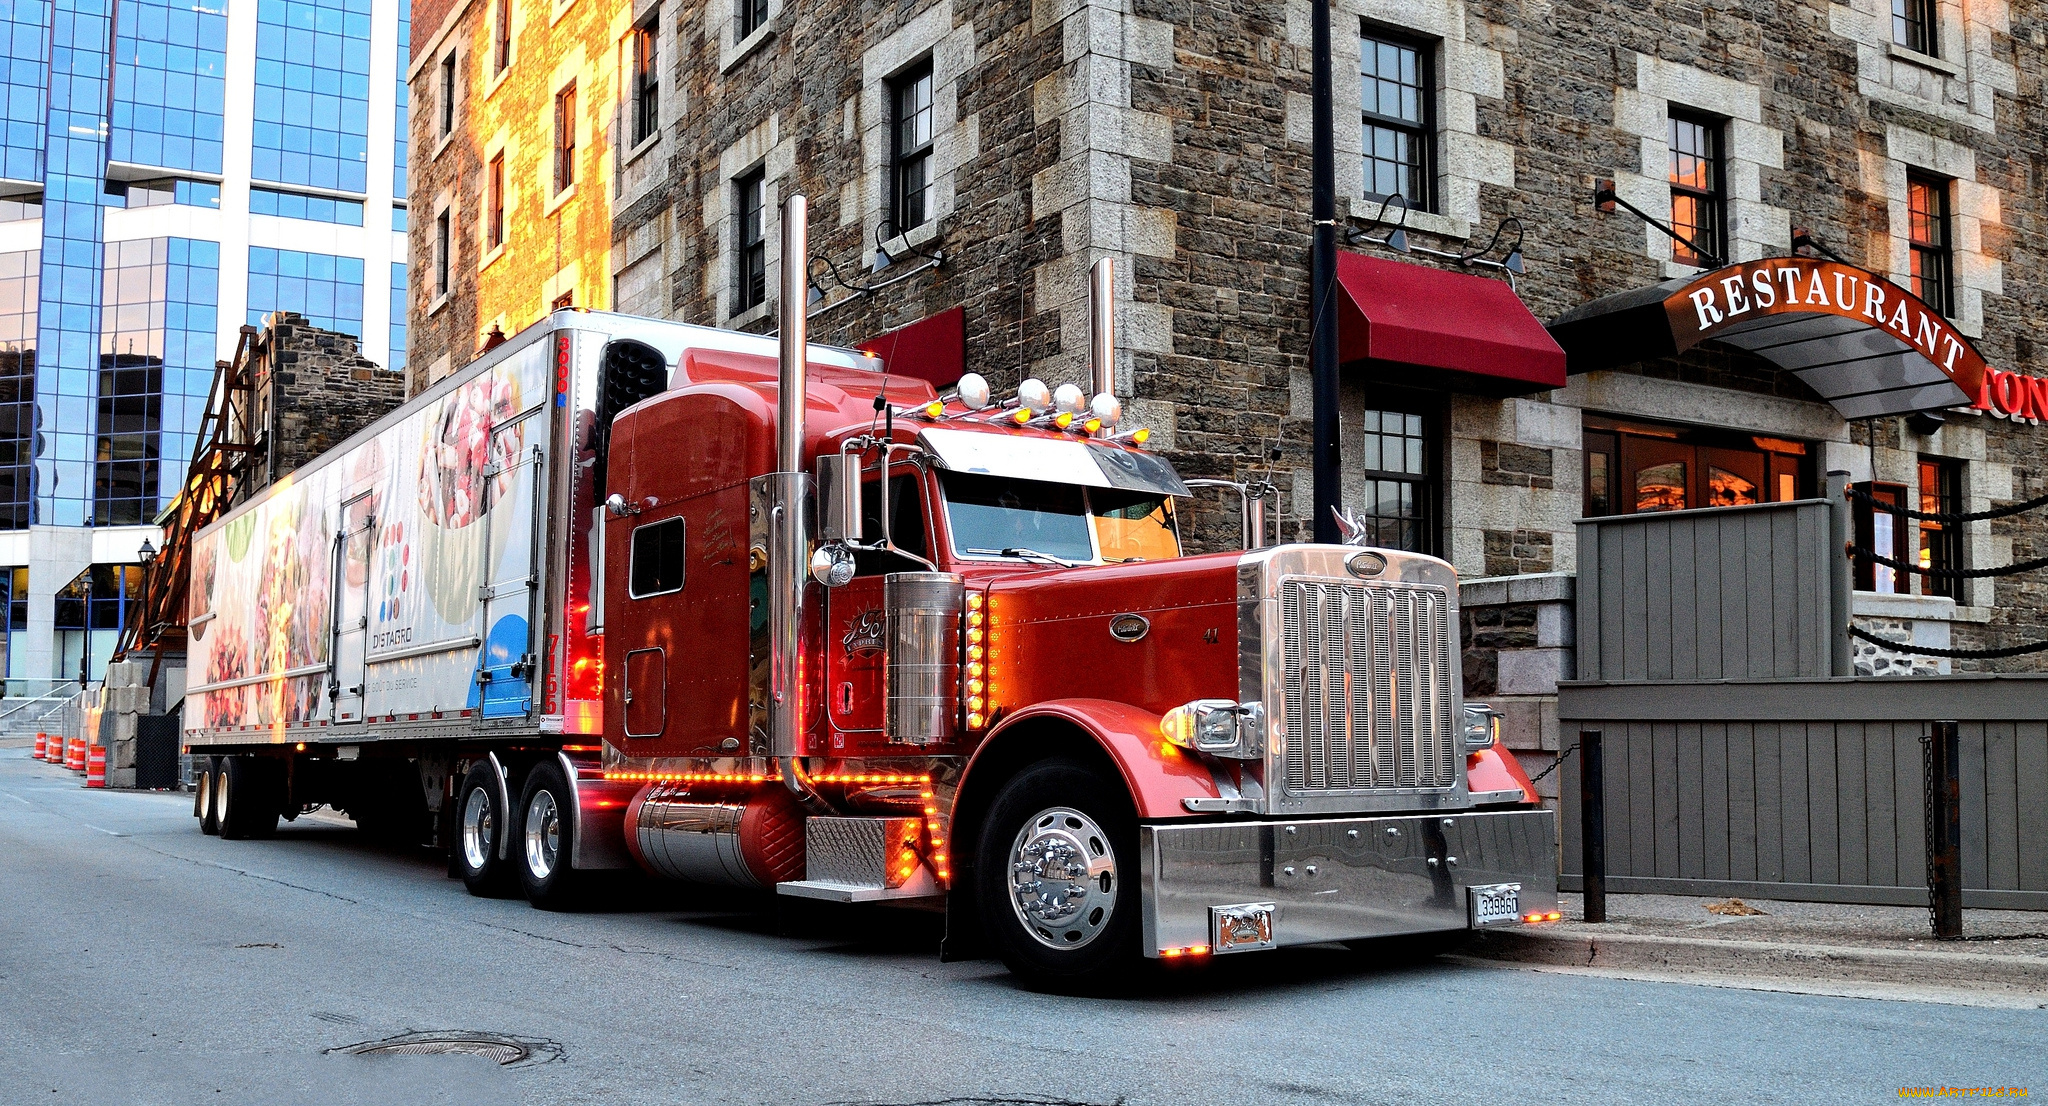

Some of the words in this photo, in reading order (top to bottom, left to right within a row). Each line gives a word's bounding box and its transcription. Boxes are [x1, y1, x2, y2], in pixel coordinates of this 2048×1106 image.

[1689, 267, 1964, 373] RESTAURANT
[373, 627, 412, 649] DISTAGRO
[1203, 627, 1219, 645] 41
[545, 634, 559, 715] 7155
